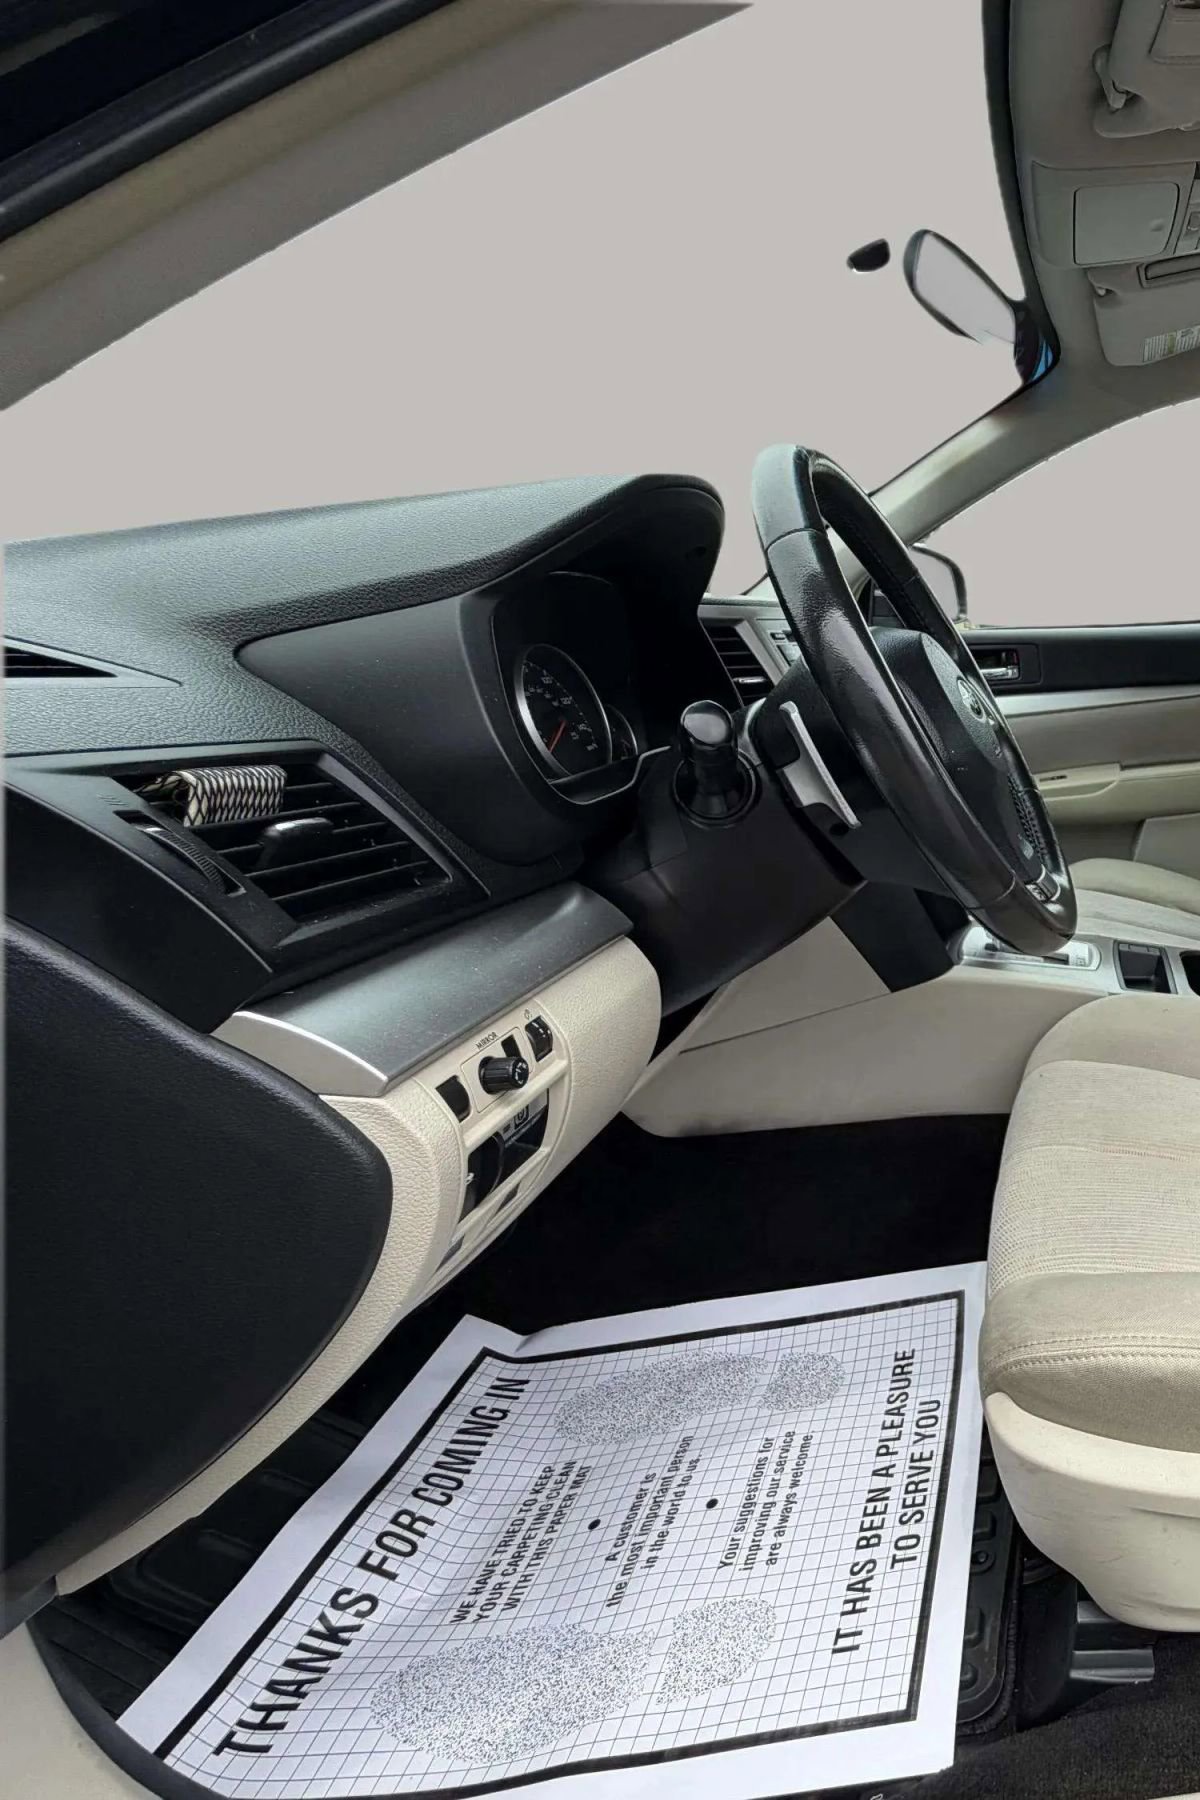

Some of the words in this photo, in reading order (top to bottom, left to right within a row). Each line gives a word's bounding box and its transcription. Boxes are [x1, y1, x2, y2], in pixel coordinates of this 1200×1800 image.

[475, 1031, 498, 1050] MIRROR
[875, 1349, 915, 1457] PLEASURE
[913, 1399, 941, 1445] YOU
[773, 1431, 796, 1474] service
[871, 1463, 896, 1478] A
[640, 1472, 657, 1484] is
[676, 1475, 693, 1488] to
[766, 1478, 781, 1498] our
[898, 1450, 934, 1526] SERVE
[606, 1581, 628, 1607] the
[620, 1540, 646, 1577] most
[634, 1474, 676, 1537] important
[667, 1435, 694, 1473] person
[612, 1487, 649, 1548] customer
[662, 1490, 686, 1526] world
[717, 1537, 741, 1570] Your
[733, 1456, 769, 1533] suggestions
[757, 1437, 774, 1453] for
[773, 1492, 798, 1538] always
[855, 1486, 891, 1550] BEEN
[450, 1600, 477, 1623] WE
[467, 1560, 502, 1596] HAVE
[492, 1517, 526, 1555] TRIED
[517, 1498, 538, 1514] TO
[529, 1466, 555, 1495] KEEP
[472, 1581, 510, 1623] YOUR
[500, 1503, 554, 1577] CARPETING
[545, 1461, 577, 1500] CLEAN
[500, 1573, 534, 1612] WITH
[524, 1537, 554, 1570] THIS
[544, 1492, 577, 1534] PAPER
[569, 1466, 591, 1490] MAT
[604, 1551, 621, 1562] A
[648, 1530, 670, 1552] the
[742, 1501, 777, 1571] improving
[765, 1542, 782, 1566] are
[890, 1534, 921, 1569] TO
[212, 1588, 379, 1756] THANKS
[355, 1512, 436, 1580] FOR
[411, 1406, 510, 1506] COMING
[484, 1377, 531, 1400] IN
[640, 1556, 659, 1569] in
[840, 1558, 877, 1617] HAS
[831, 1628, 863, 1655] IT
